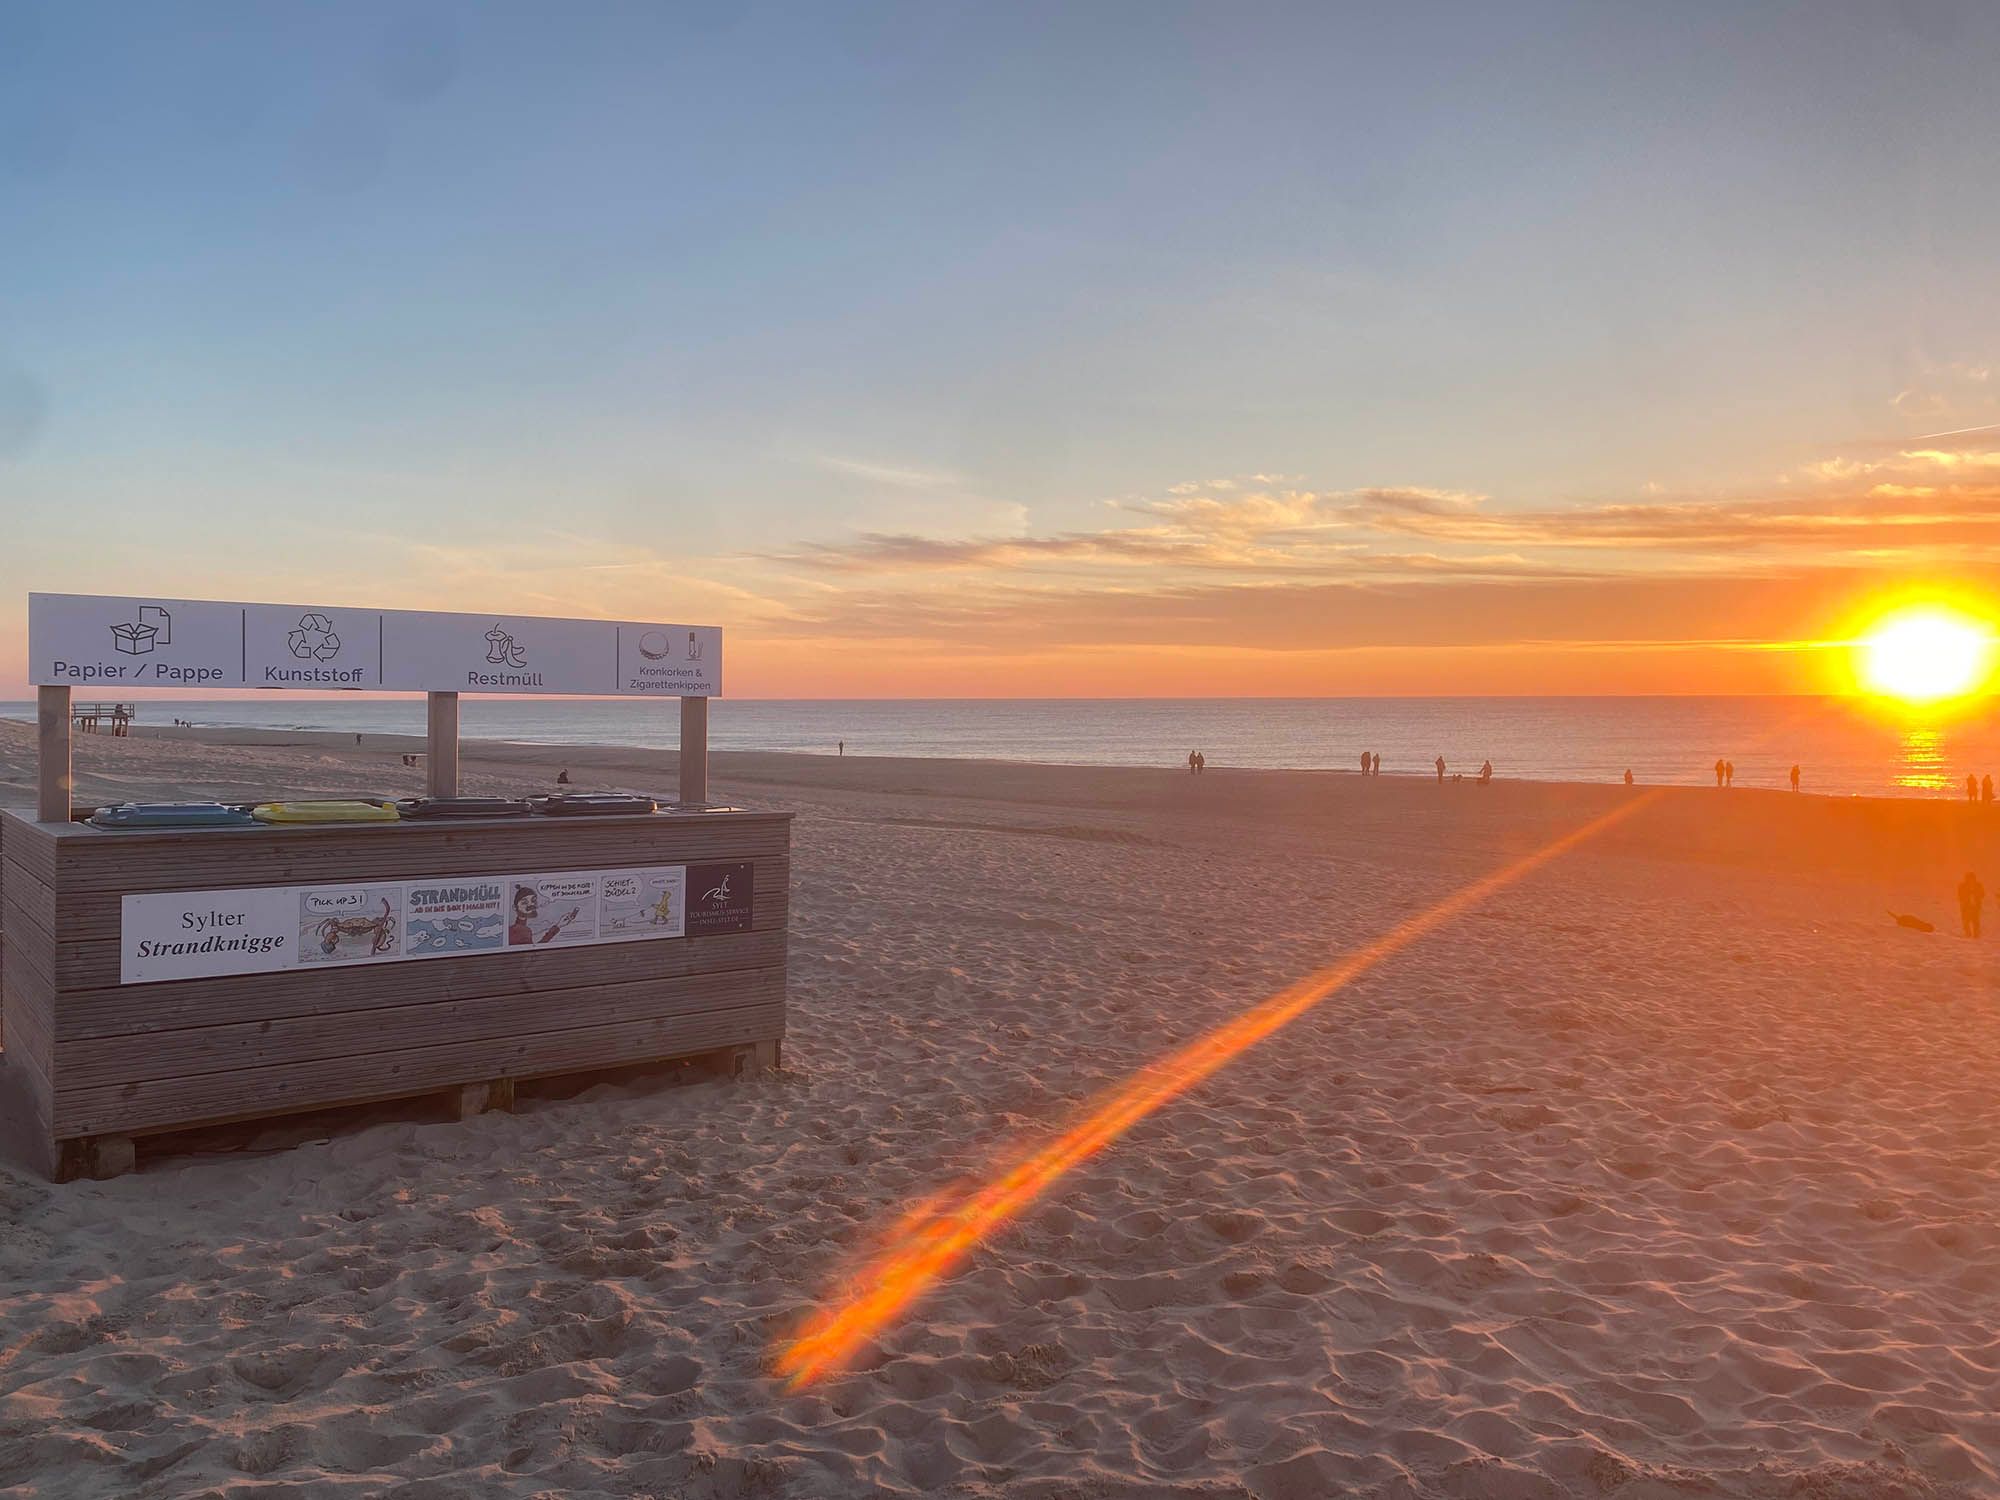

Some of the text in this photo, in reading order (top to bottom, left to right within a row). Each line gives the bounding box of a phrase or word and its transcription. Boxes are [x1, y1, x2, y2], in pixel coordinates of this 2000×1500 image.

[54, 661, 223, 683] Papier / Pappe
[265, 666, 363, 682] Kunststoff
[468, 671, 543, 686] Restmüll
[639, 666, 702, 678] Kronkorken &
[630, 679, 711, 691] Zigarettenkippen
[311, 897, 333, 906] PICK
[410, 884, 500, 905] STRANDMÜLL
[182, 911, 245, 932] Sylter
[137, 934, 284, 958] Strandknigge
